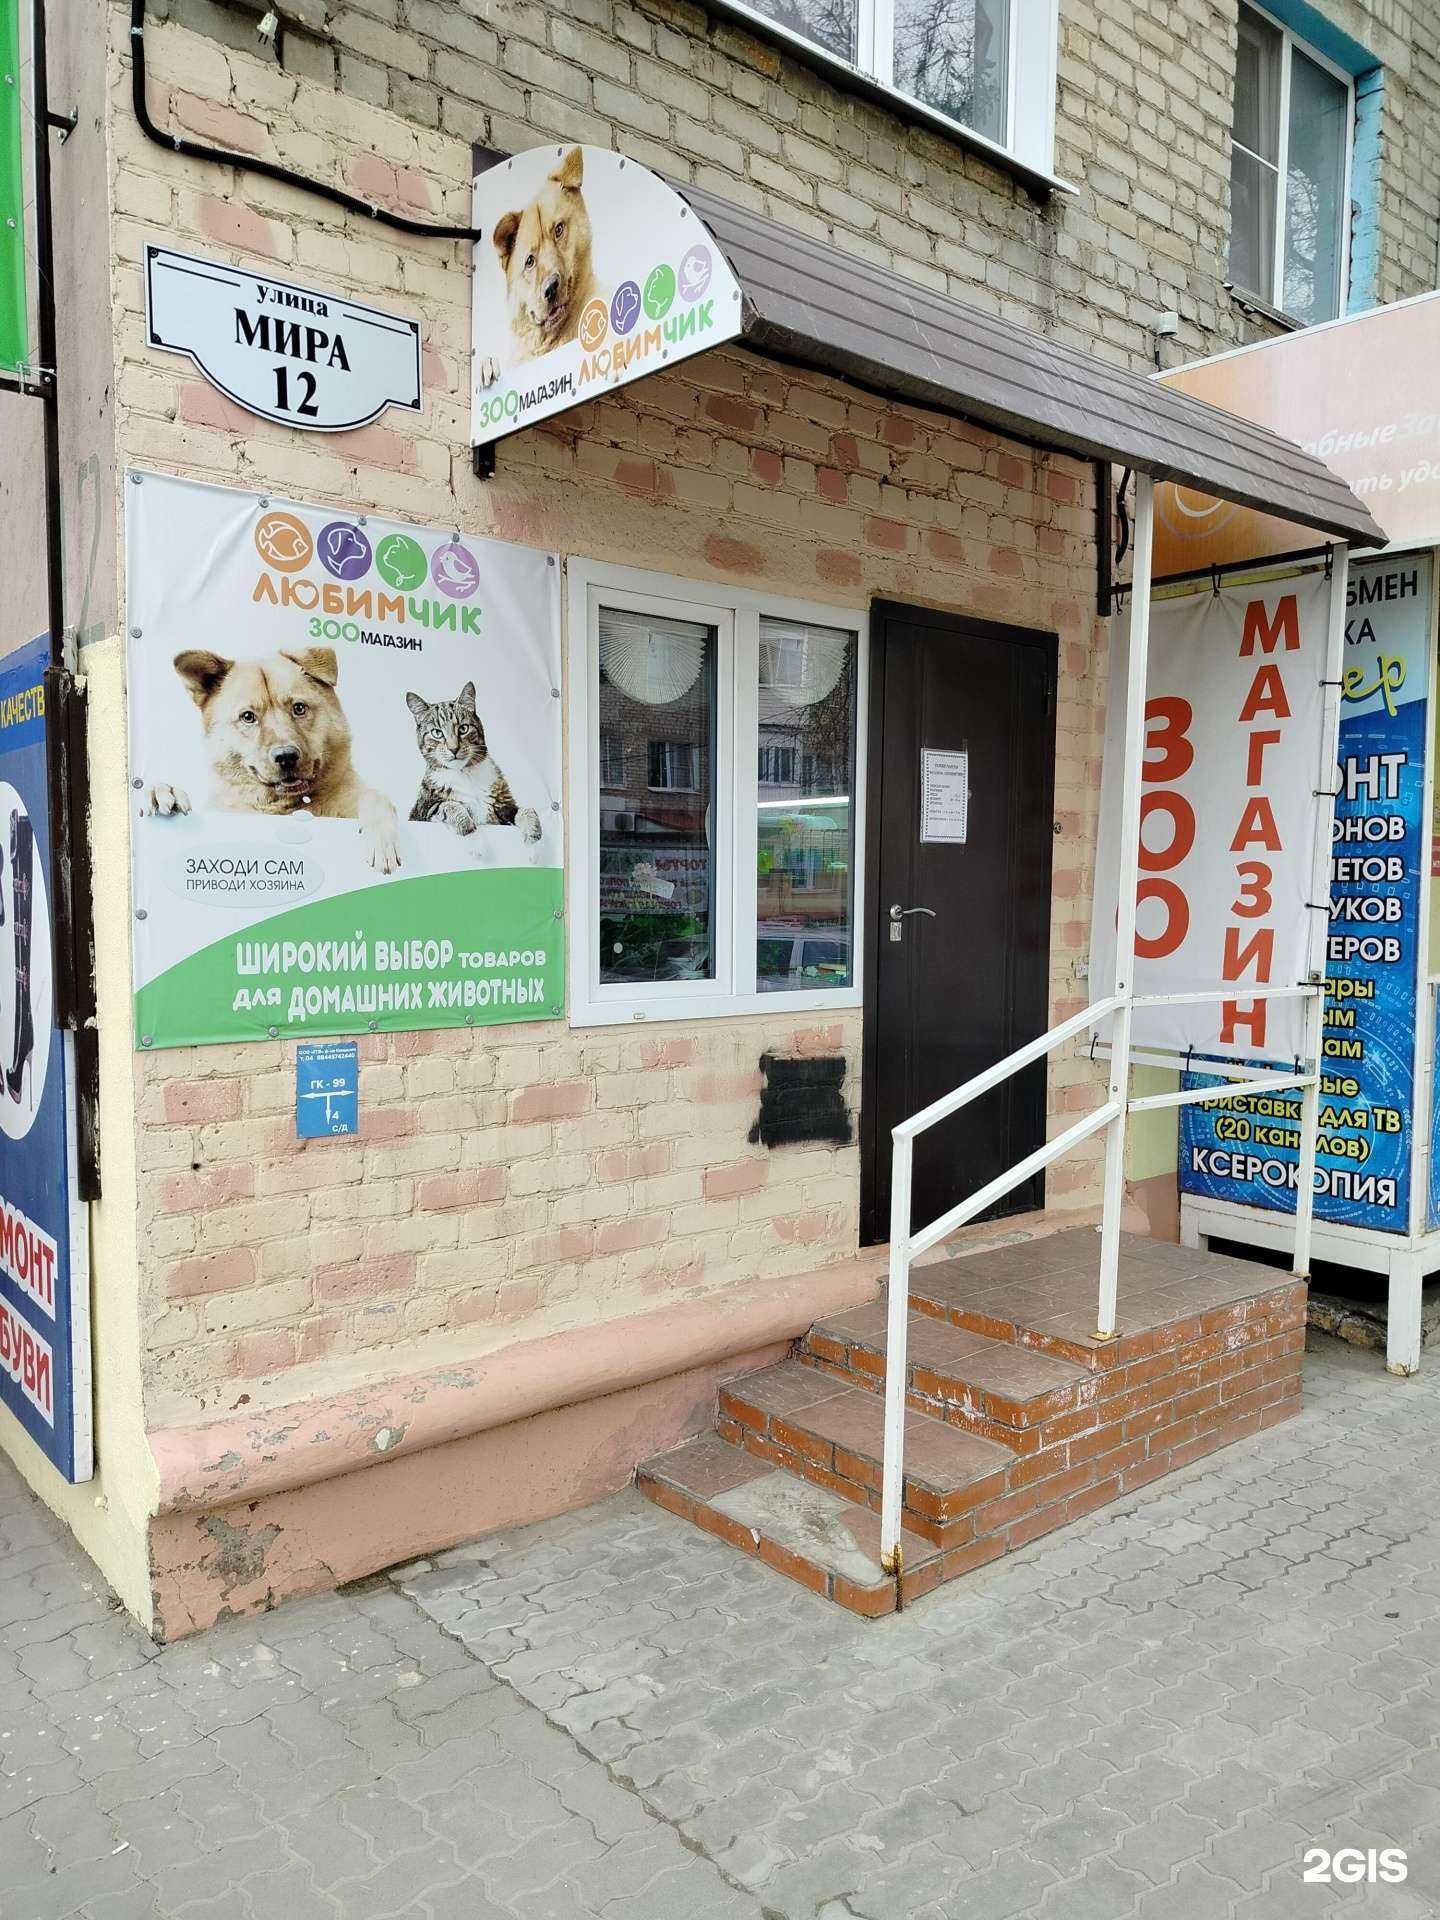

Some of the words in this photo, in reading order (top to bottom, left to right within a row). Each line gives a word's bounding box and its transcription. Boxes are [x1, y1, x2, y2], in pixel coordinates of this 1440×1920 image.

[256, 284, 329, 318] улица
[233, 307, 352, 373] МИРА
[577, 298, 715, 387] ЛЮБИМЧИК
[272, 366, 320, 418] 12
[252, 572, 483, 636] ЛЮБИМЧИК
[1334, 753, 1407, 801] НТ
[186, 858, 259, 877] ЗАХОДИ
[264, 859, 304, 875] САМ
[186, 879, 246, 892] ПРИВОДИ
[249, 880, 305, 891] ХОЗЯИНА
[1332, 857, 1404, 881] ЕТОВ
[236, 930, 368, 975] ШИРОКИЙ
[374, 939, 454, 971] ВЫБОР
[1327, 937, 1401, 961] ЕРОВ
[287, 981, 423, 1023] ДОМАШНИХ
[427, 977, 545, 1009] ЖИВОТНЫХ
[310, 1080, 324, 1089] ГК
[332, 1078, 346, 1088] 99
[331, 1111, 339, 1120] 4
[1320, 1107, 1367, 1129] для
[1373, 1108, 1401, 1132] ТВ
[1215, 1117, 1250, 1140] (20
[1255, 1125, 1369, 1161] канлов)
